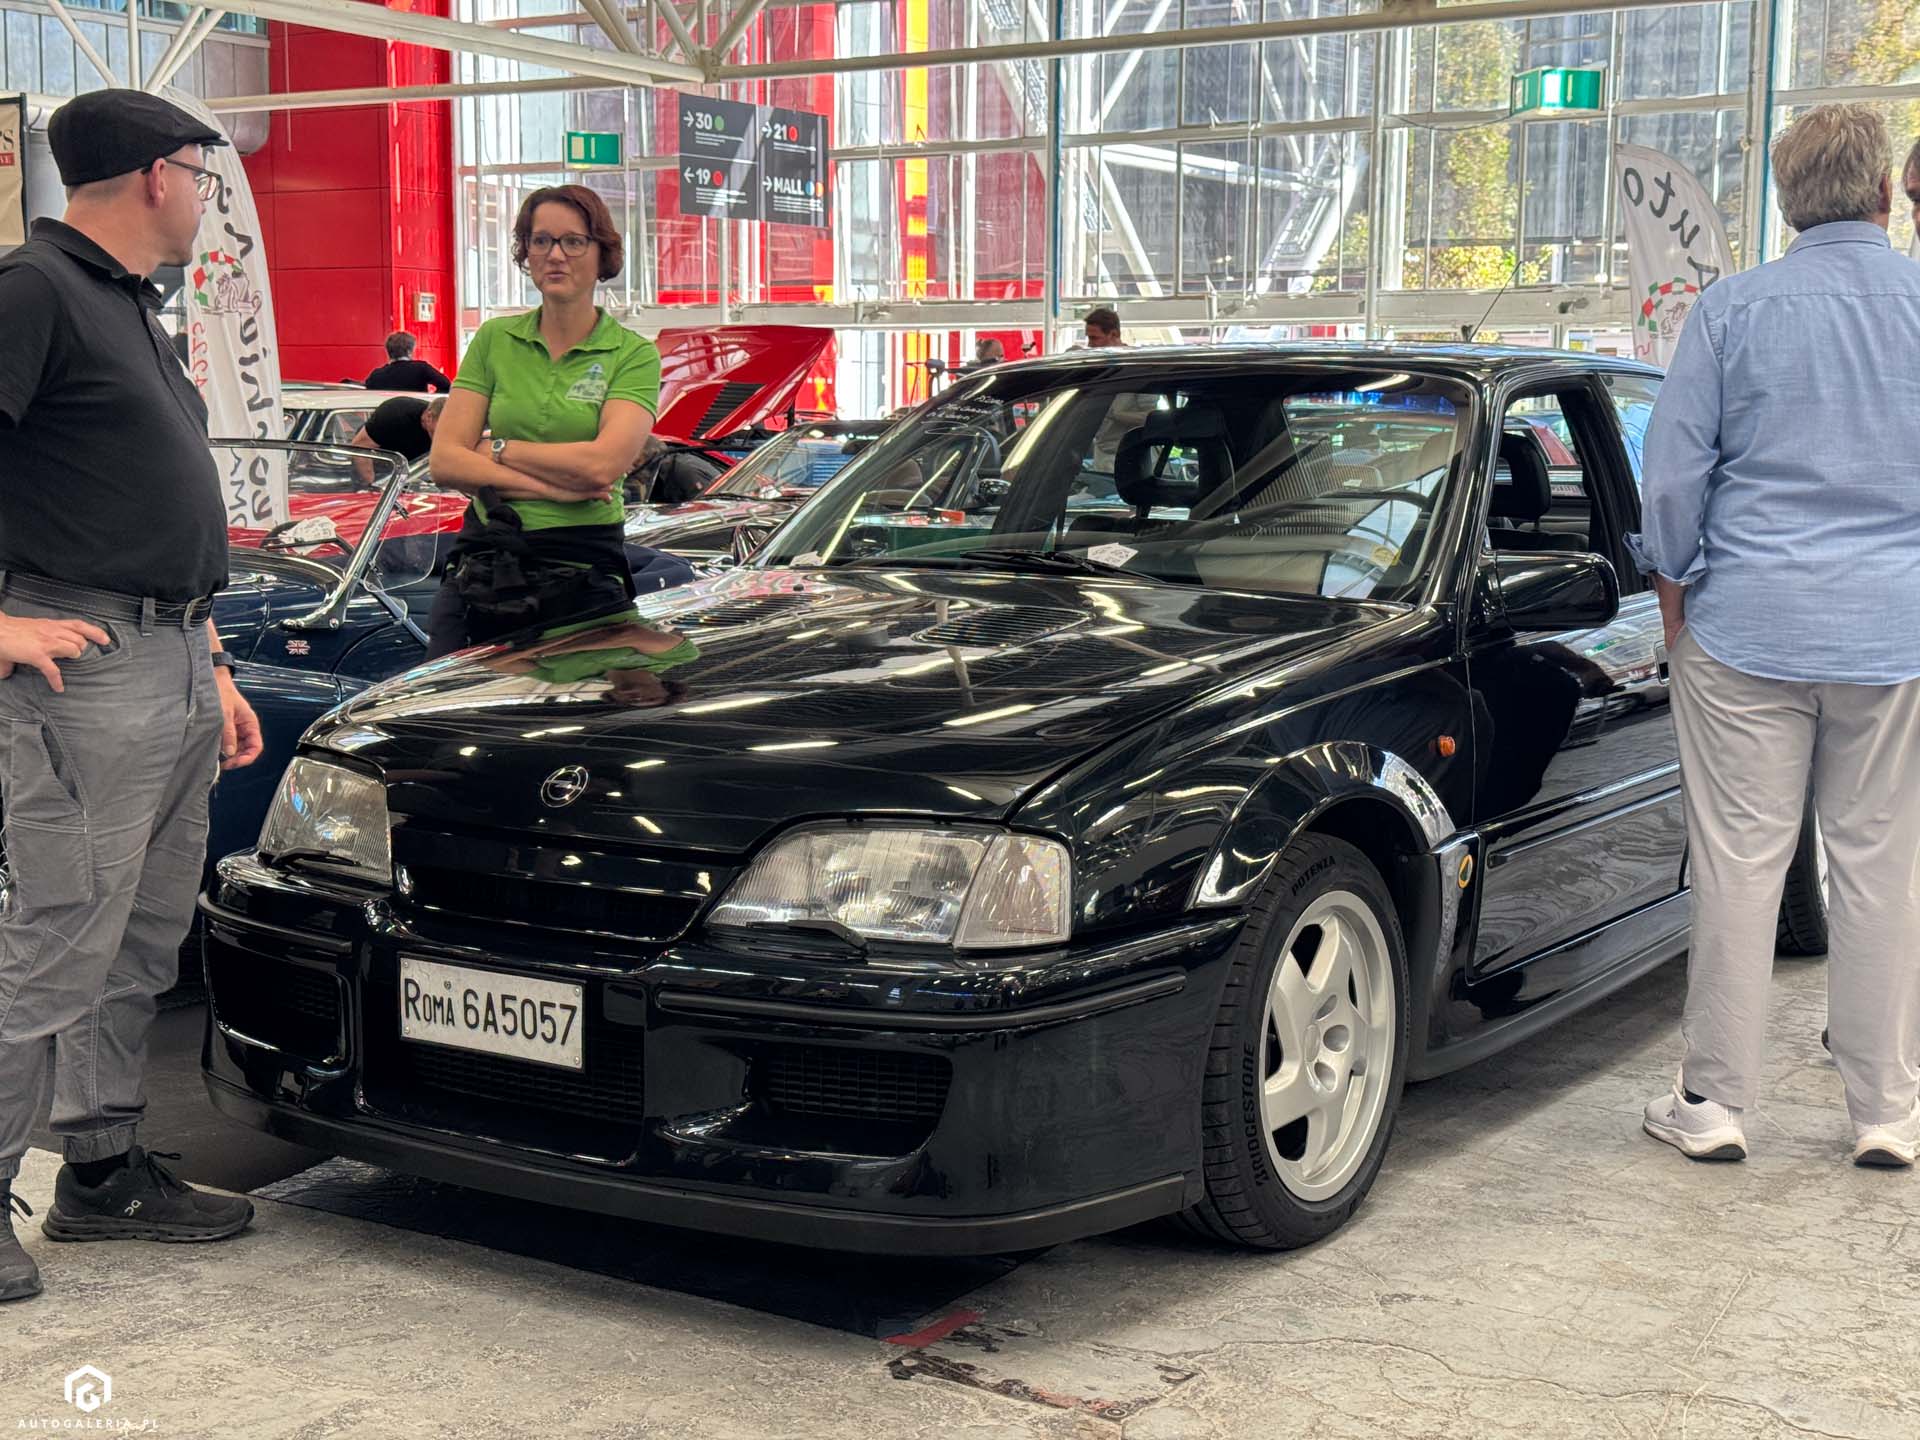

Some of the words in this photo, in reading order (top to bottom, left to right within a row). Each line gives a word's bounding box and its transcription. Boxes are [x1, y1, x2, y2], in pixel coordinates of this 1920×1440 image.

[695, 112, 713, 130] 30
[773, 123, 788, 140] 21
[696, 167, 711, 185] 19
[773, 177, 805, 195] MALL
[1291, 855, 1336, 897] POTENZA
[463, 988, 578, 1046] 6A5057
[1242, 1040, 1270, 1187] BRIDGESTONE
